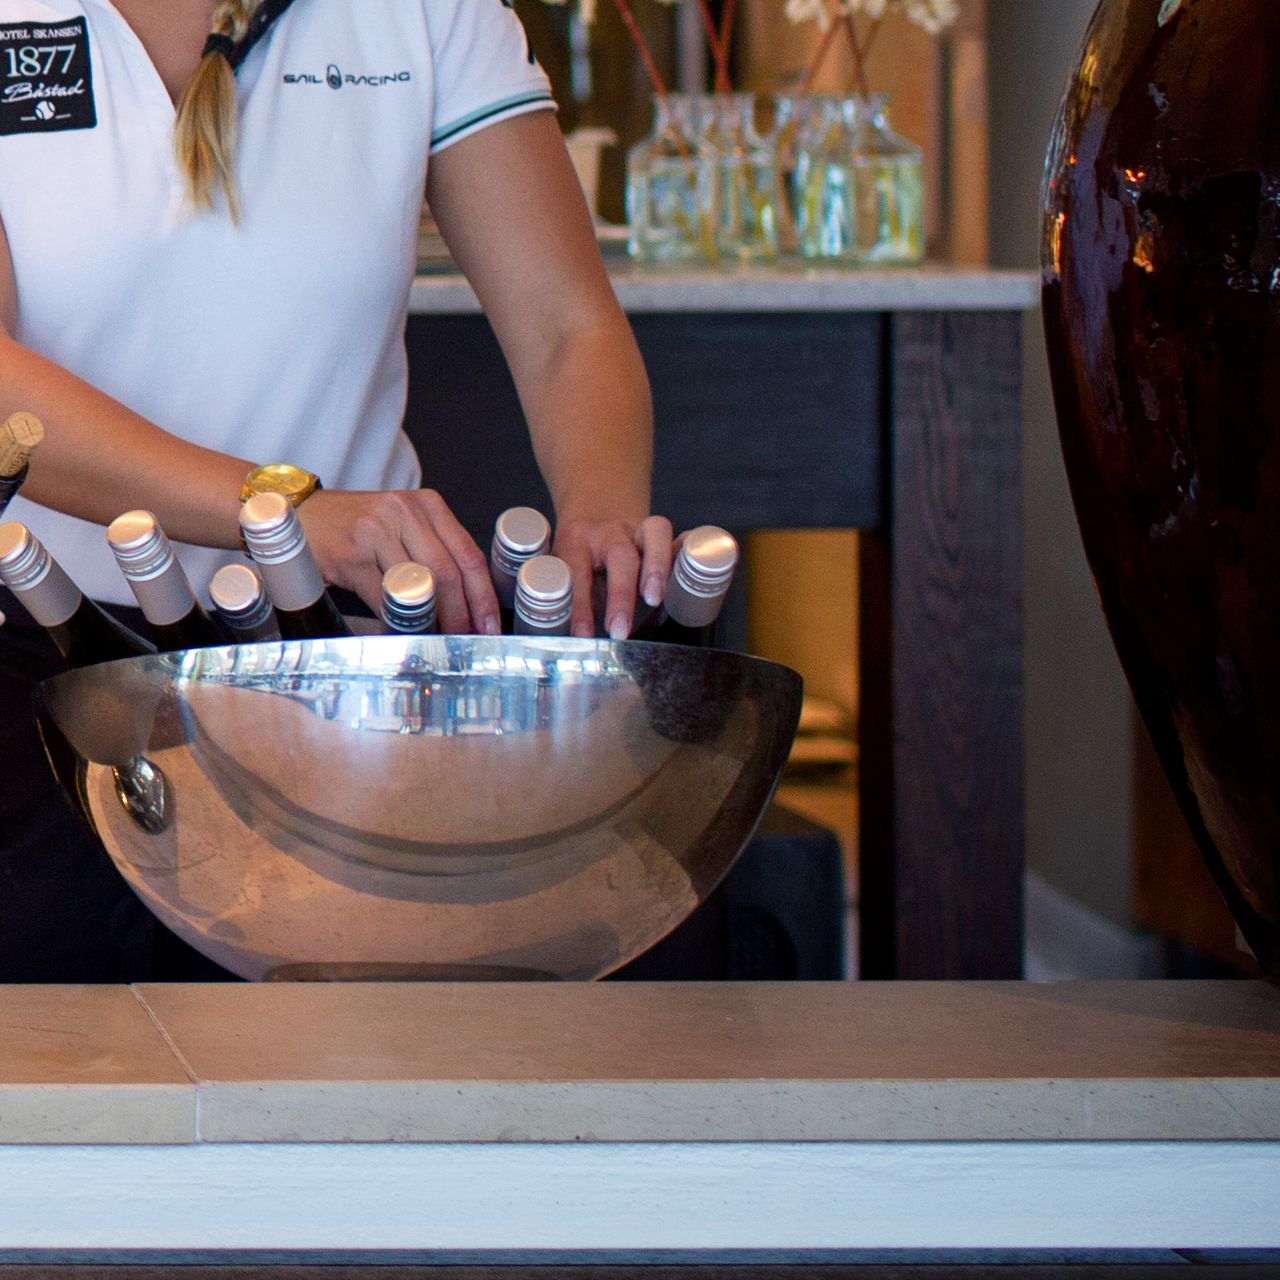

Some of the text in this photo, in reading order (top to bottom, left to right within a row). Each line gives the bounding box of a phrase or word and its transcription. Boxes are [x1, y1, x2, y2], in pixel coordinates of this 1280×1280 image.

[33, 25, 82, 39] SKANSEN
[4, 43, 77, 77] 1877
[283, 71, 411, 86] SAIL RACING
[1, 78, 85, 103] Båstad
